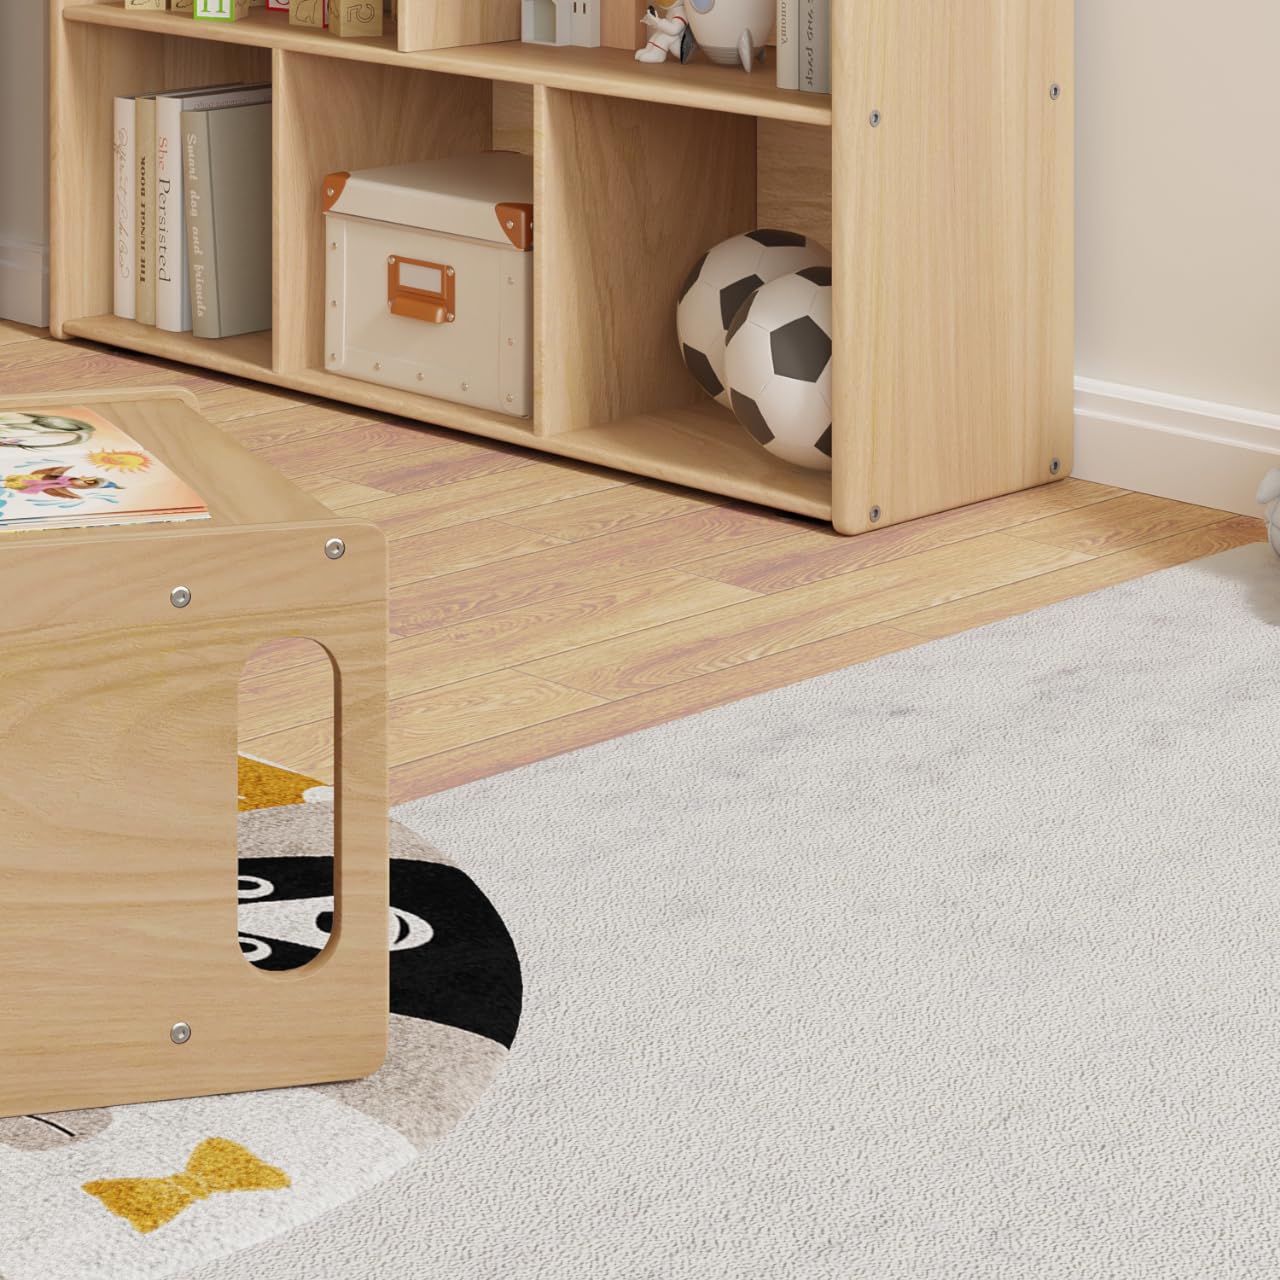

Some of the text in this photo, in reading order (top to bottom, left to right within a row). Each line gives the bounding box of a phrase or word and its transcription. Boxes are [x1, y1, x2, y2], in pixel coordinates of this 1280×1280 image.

[158, 136, 171, 283] She Persisted
[186, 134, 206, 317] Smart dog and friends
